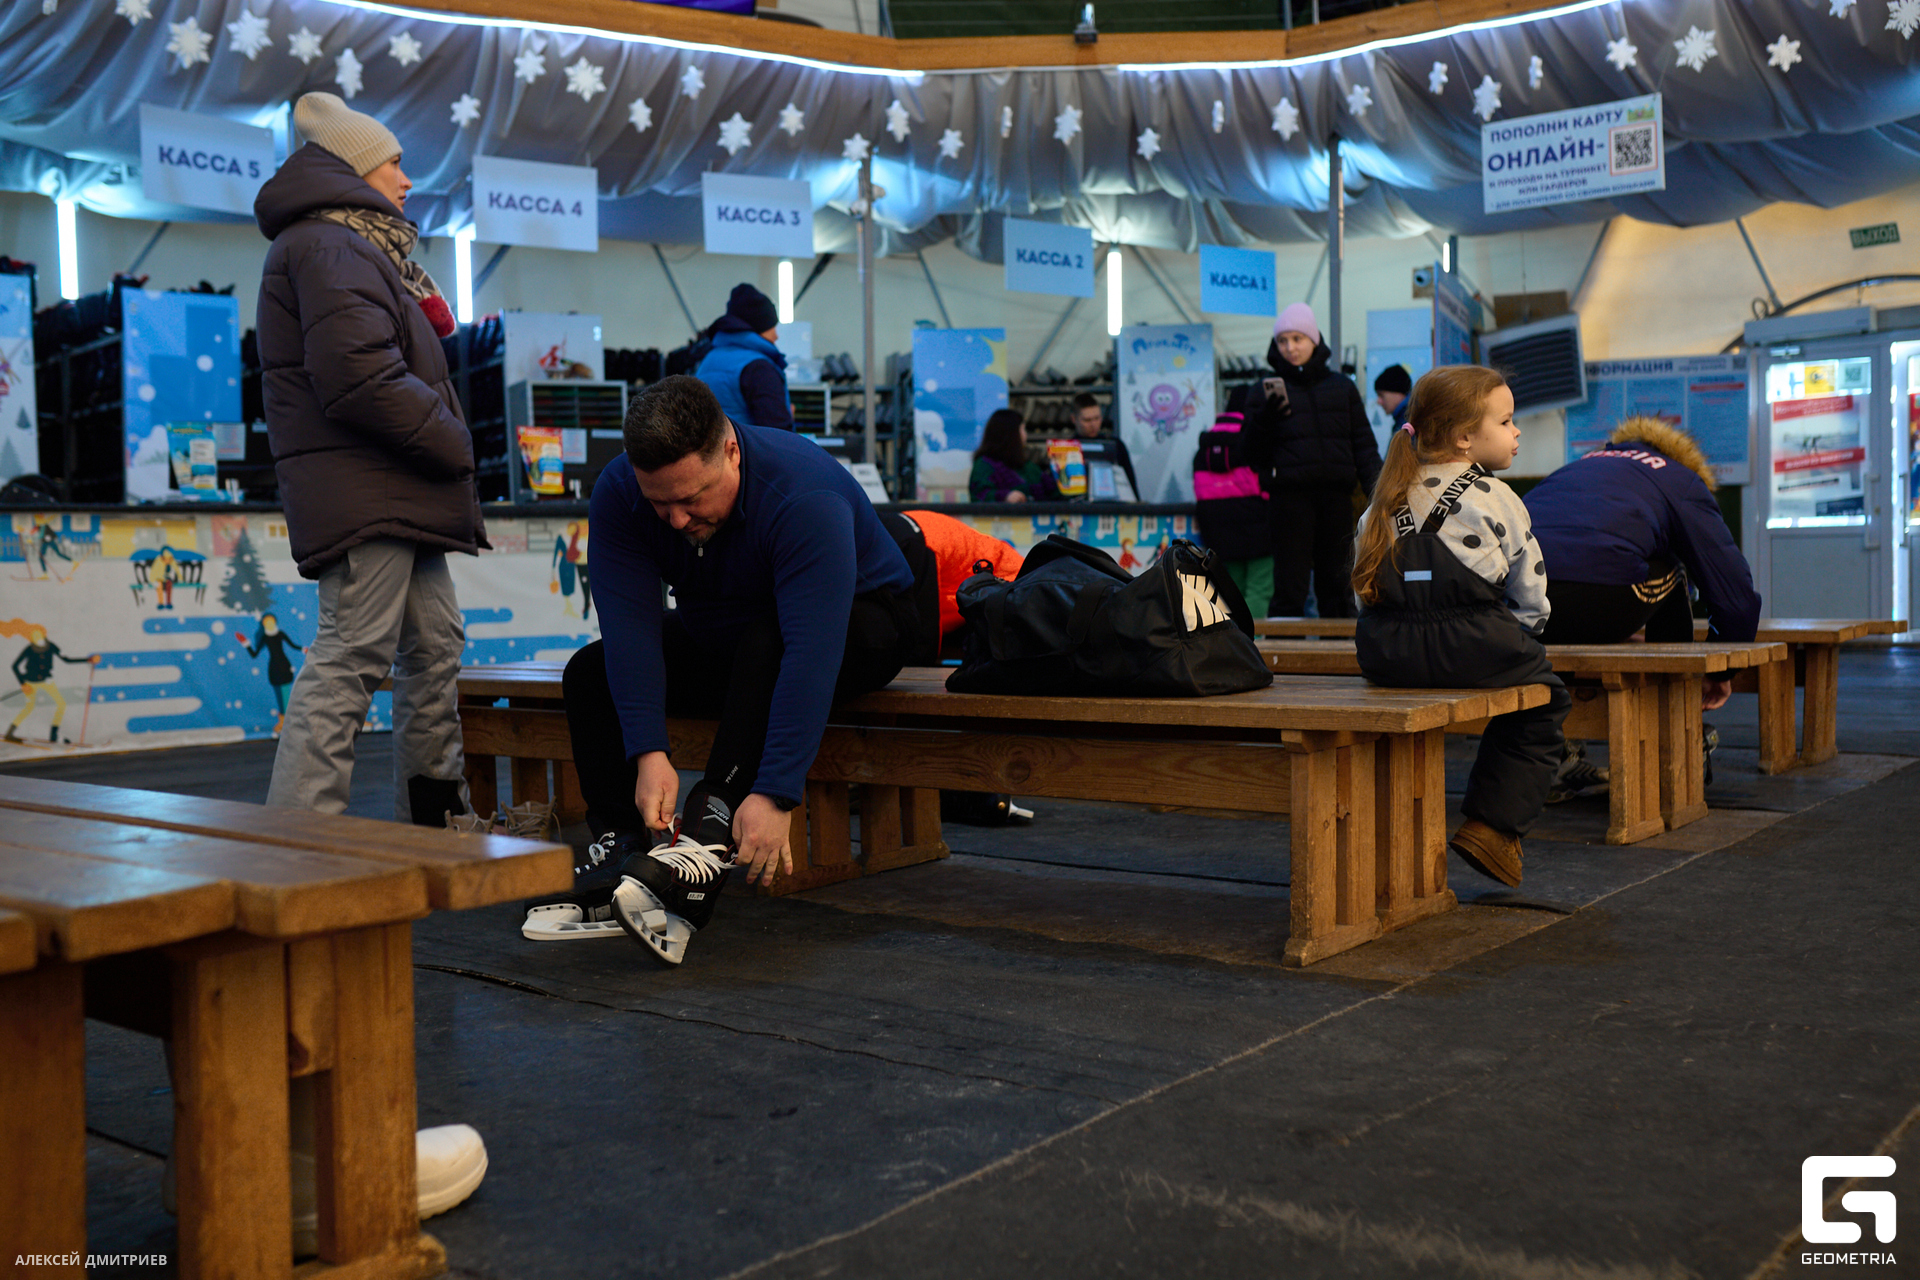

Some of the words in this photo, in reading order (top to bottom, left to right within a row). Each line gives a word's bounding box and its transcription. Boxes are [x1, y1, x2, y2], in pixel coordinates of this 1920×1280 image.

[1490, 118, 1568, 143] ПОПОЛНИ
[1573, 109, 1624, 129] КАРТУ
[158, 145, 242, 176] КАССА
[249, 160, 260, 178] 5
[1497, 174, 1543, 188] ПРОХОДИ
[1545, 172, 1558, 181] НА
[1560, 164, 1608, 179] ТУРНИКЕТ
[1518, 186, 1539, 196] ИЛИ
[489, 191, 565, 215] КАССА
[571, 201, 582, 216] 4
[717, 205, 786, 226] КАССА
[791, 210, 801, 226] 3
[1016, 248, 1072, 268] КАССА
[1075, 254, 1084, 269] 2
[1210, 272, 1260, 291] КАССА
[1261, 276, 1268, 291] 1
[1585, 360, 1673, 377] ФОРМАЦИЯ
